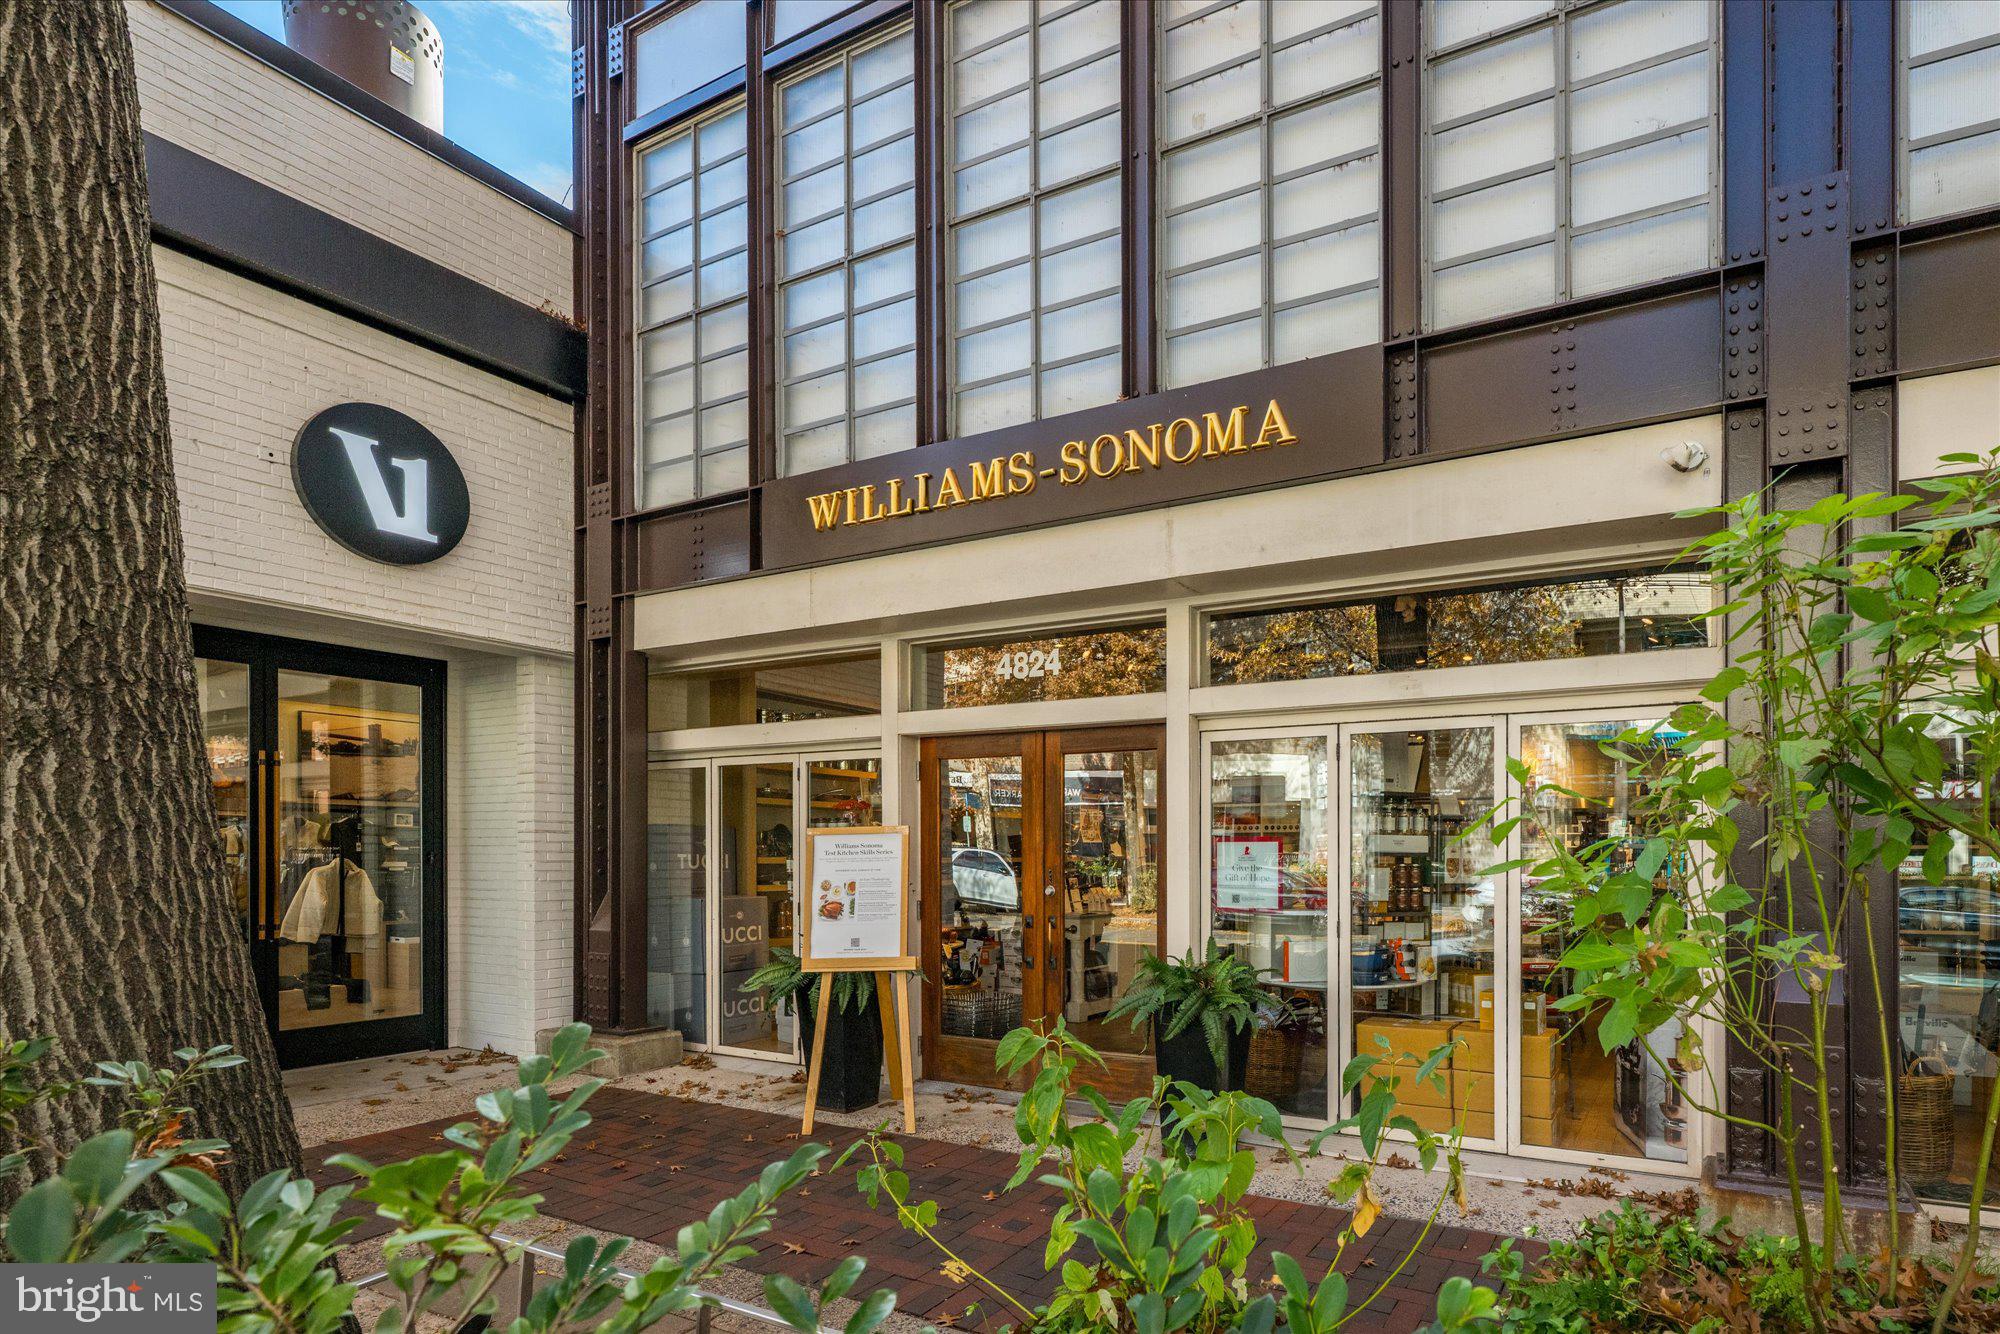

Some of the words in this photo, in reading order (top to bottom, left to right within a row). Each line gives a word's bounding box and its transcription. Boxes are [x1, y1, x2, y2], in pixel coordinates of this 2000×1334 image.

[806, 399, 1298, 532] WILLIAMS-SONOMA
[995, 648, 1061, 680] 4824
[677, 853, 729, 870] TUI
[1232, 864, 1250, 872] Give
[1250, 864, 1263, 872] the
[1225, 874, 1239, 882] Gift
[1249, 873, 1270, 883] Hope
[721, 925, 762, 944] UCCI
[723, 995, 765, 1018] UCCI
